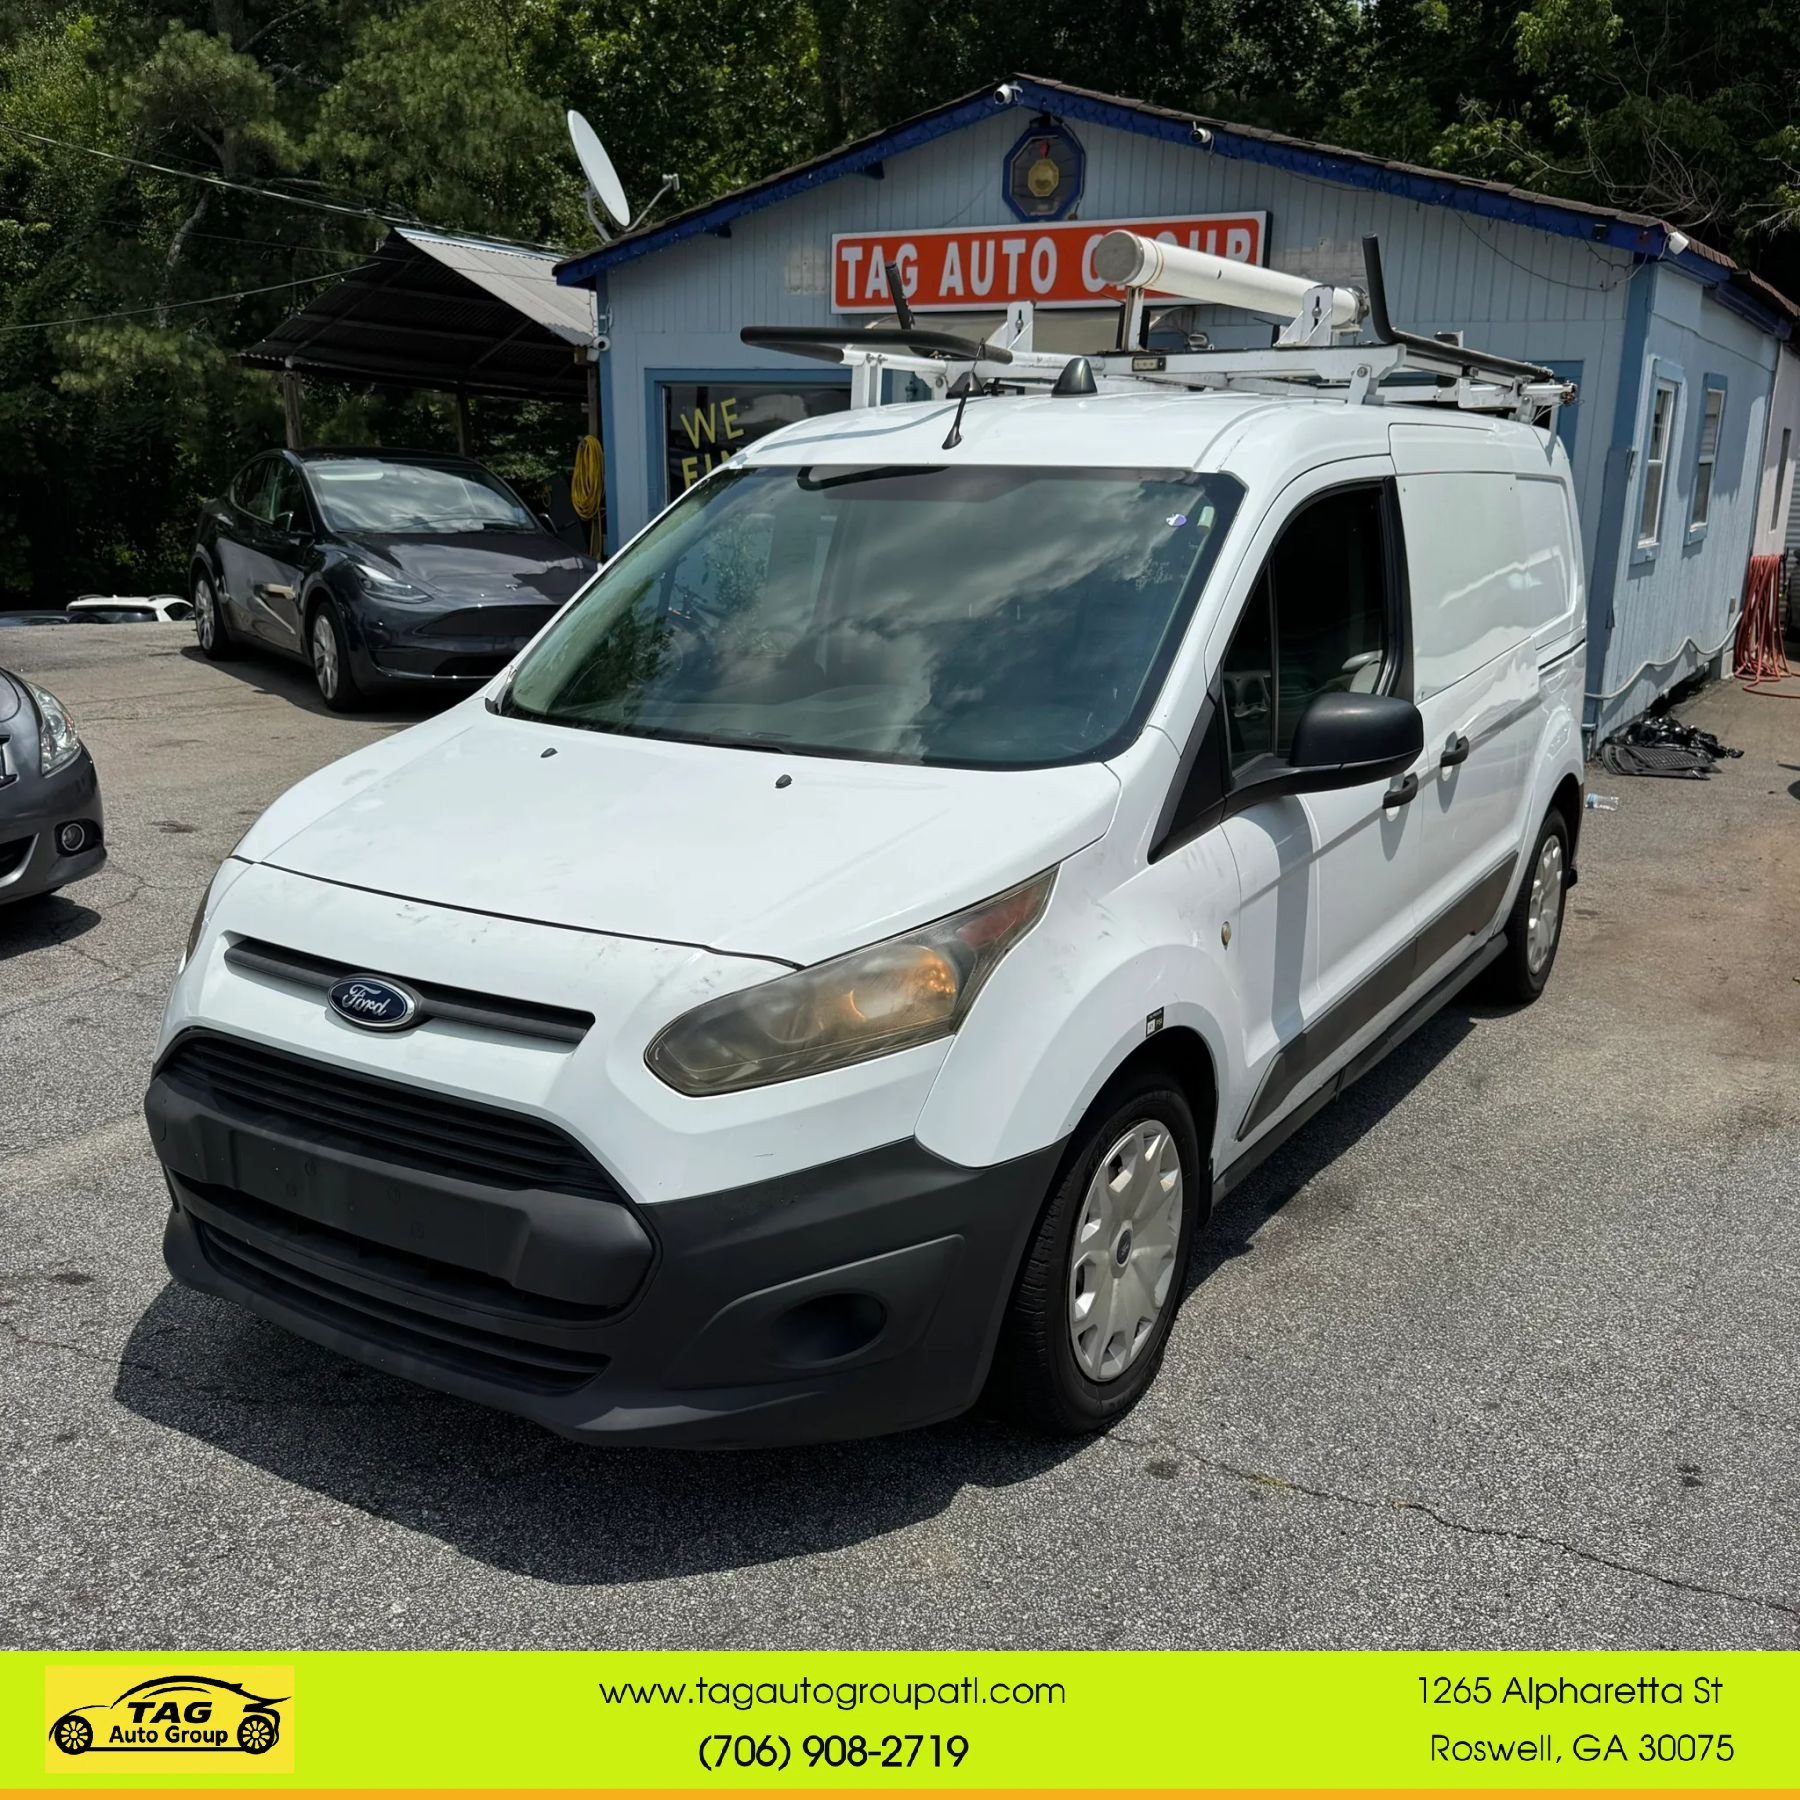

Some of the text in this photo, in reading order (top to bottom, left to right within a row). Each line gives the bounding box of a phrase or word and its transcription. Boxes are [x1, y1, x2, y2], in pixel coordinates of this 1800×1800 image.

[841, 243, 918, 299] TAG
[938, 236, 1058, 297] AUTO
[680, 397, 745, 449] WE
[341, 984, 391, 1016] Ford
